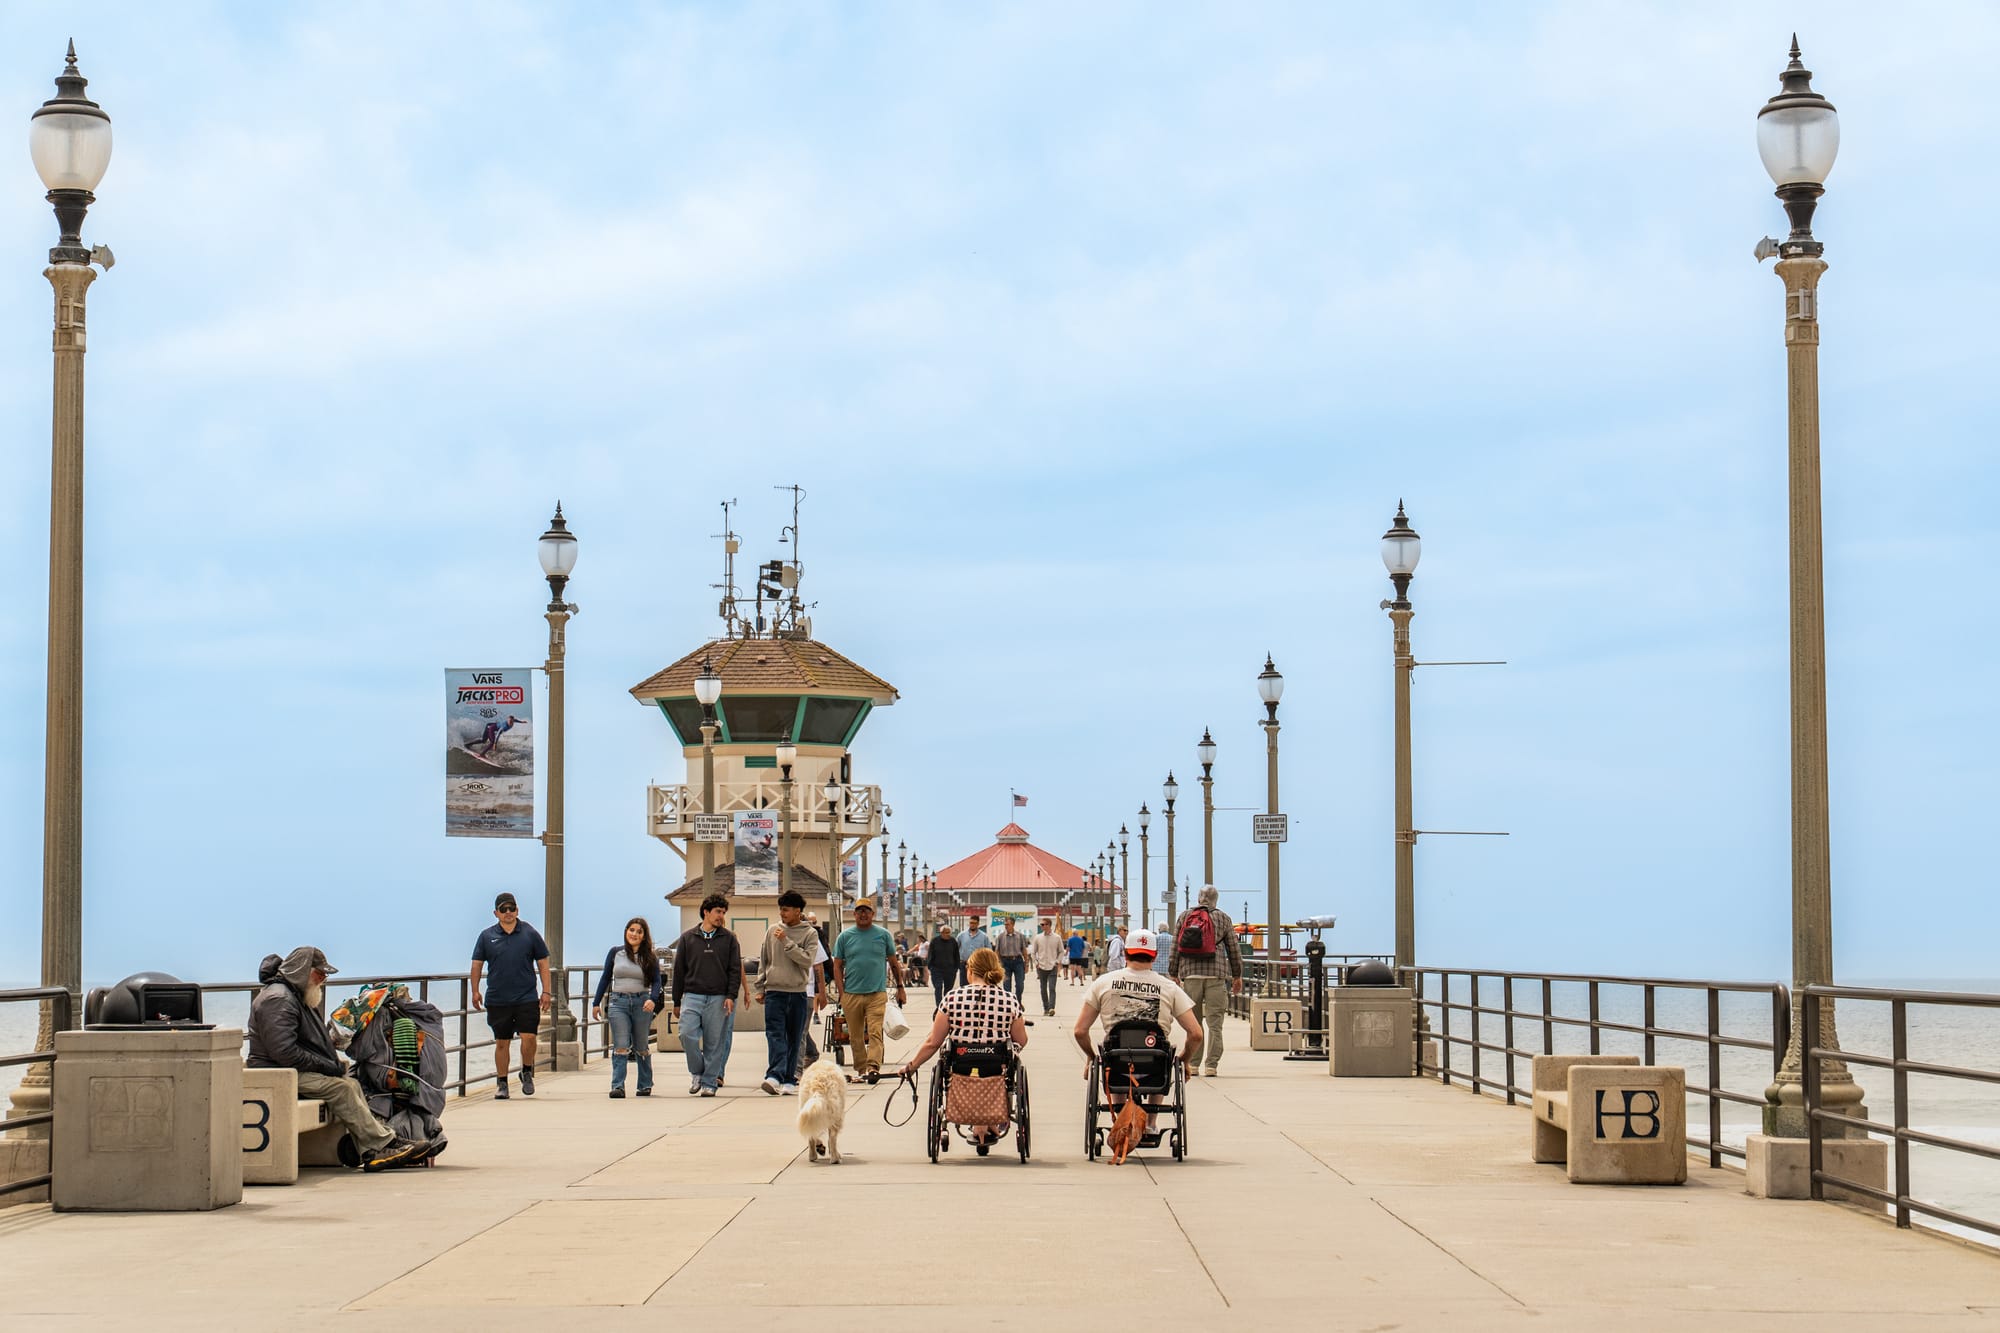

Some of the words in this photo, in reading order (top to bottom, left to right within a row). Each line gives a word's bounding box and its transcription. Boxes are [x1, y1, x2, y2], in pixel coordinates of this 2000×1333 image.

[472, 673, 503, 684] VANS
[1112, 980, 1160, 994] HUNTINGTON
[1264, 1011, 1292, 1033] HB
[1596, 1090, 1660, 1138] HB
